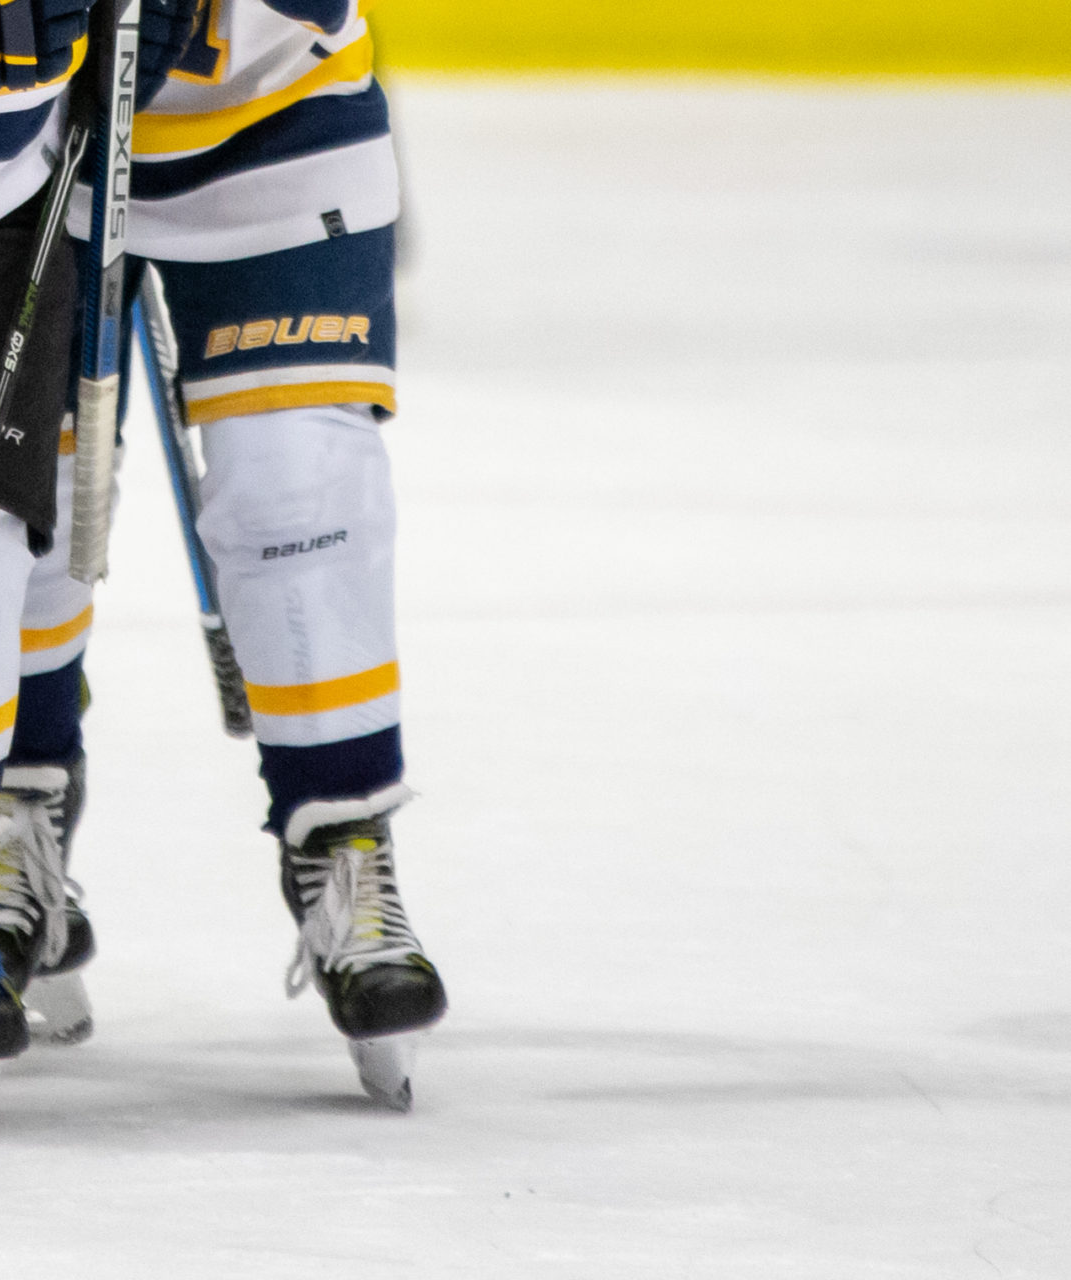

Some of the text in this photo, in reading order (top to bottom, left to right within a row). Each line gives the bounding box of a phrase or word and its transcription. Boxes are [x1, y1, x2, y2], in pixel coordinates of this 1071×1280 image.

[109, 50, 135, 240] NEXUS
[203, 314, 370, 360] BAUER
[261, 529, 348, 560] BAUER
